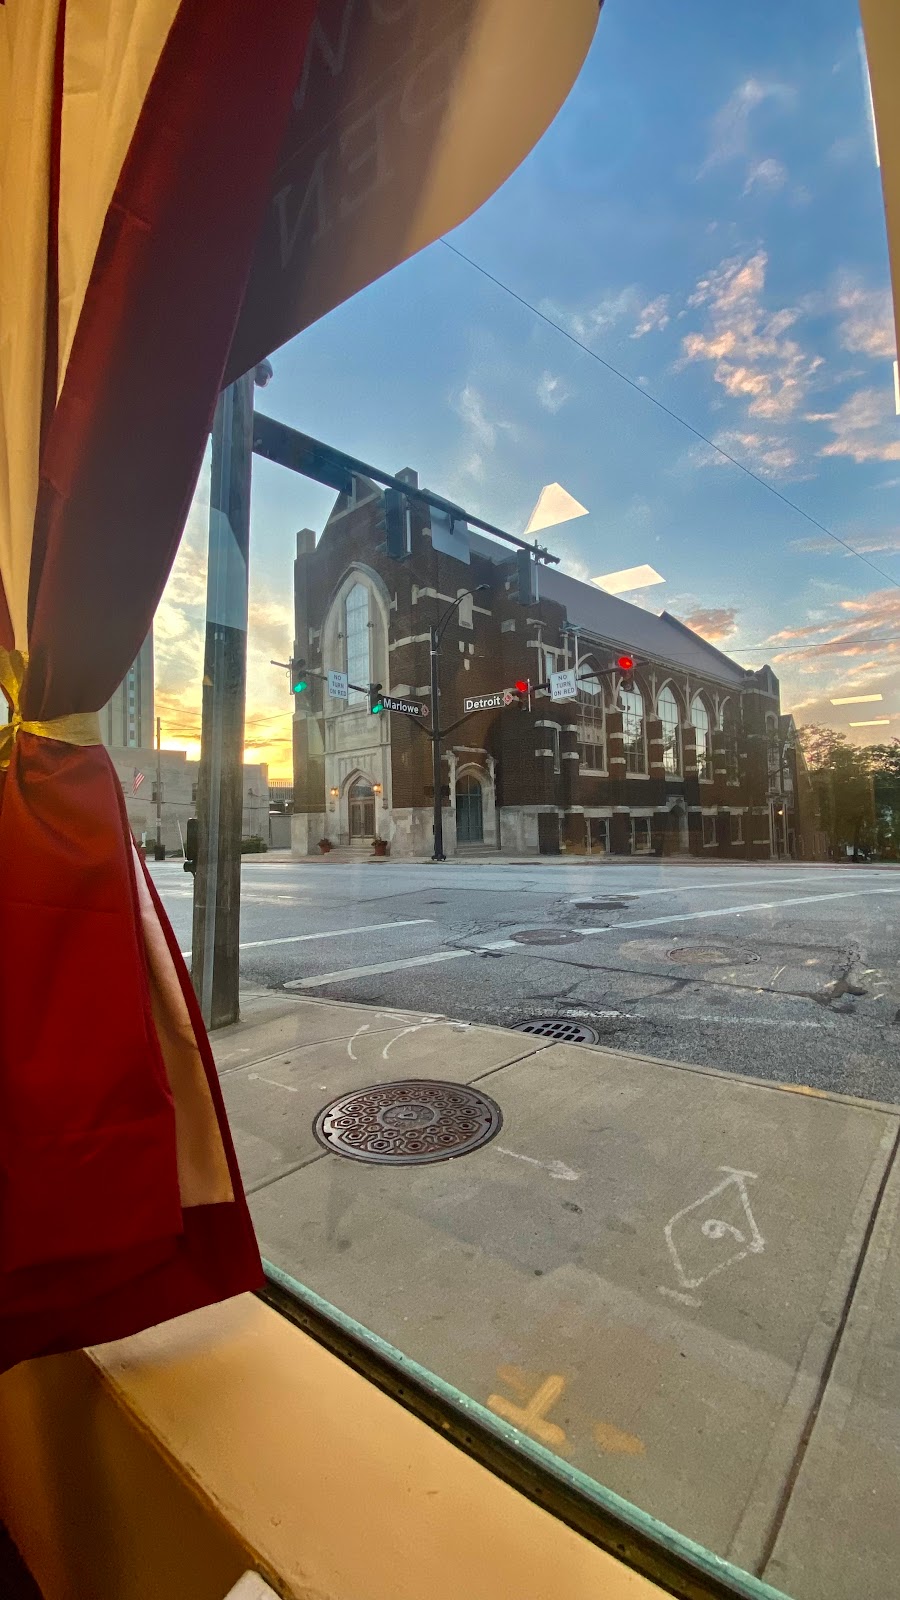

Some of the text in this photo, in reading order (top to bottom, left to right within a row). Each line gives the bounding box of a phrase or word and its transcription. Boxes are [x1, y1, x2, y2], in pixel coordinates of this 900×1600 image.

[332, 681, 345, 689] TURN
[556, 681, 571, 689] TURN
[337, 689, 347, 697] RED
[553, 689, 562, 697] ON
[383, 697, 419, 714] Marlowe
[465, 696, 501, 711] Detroit
